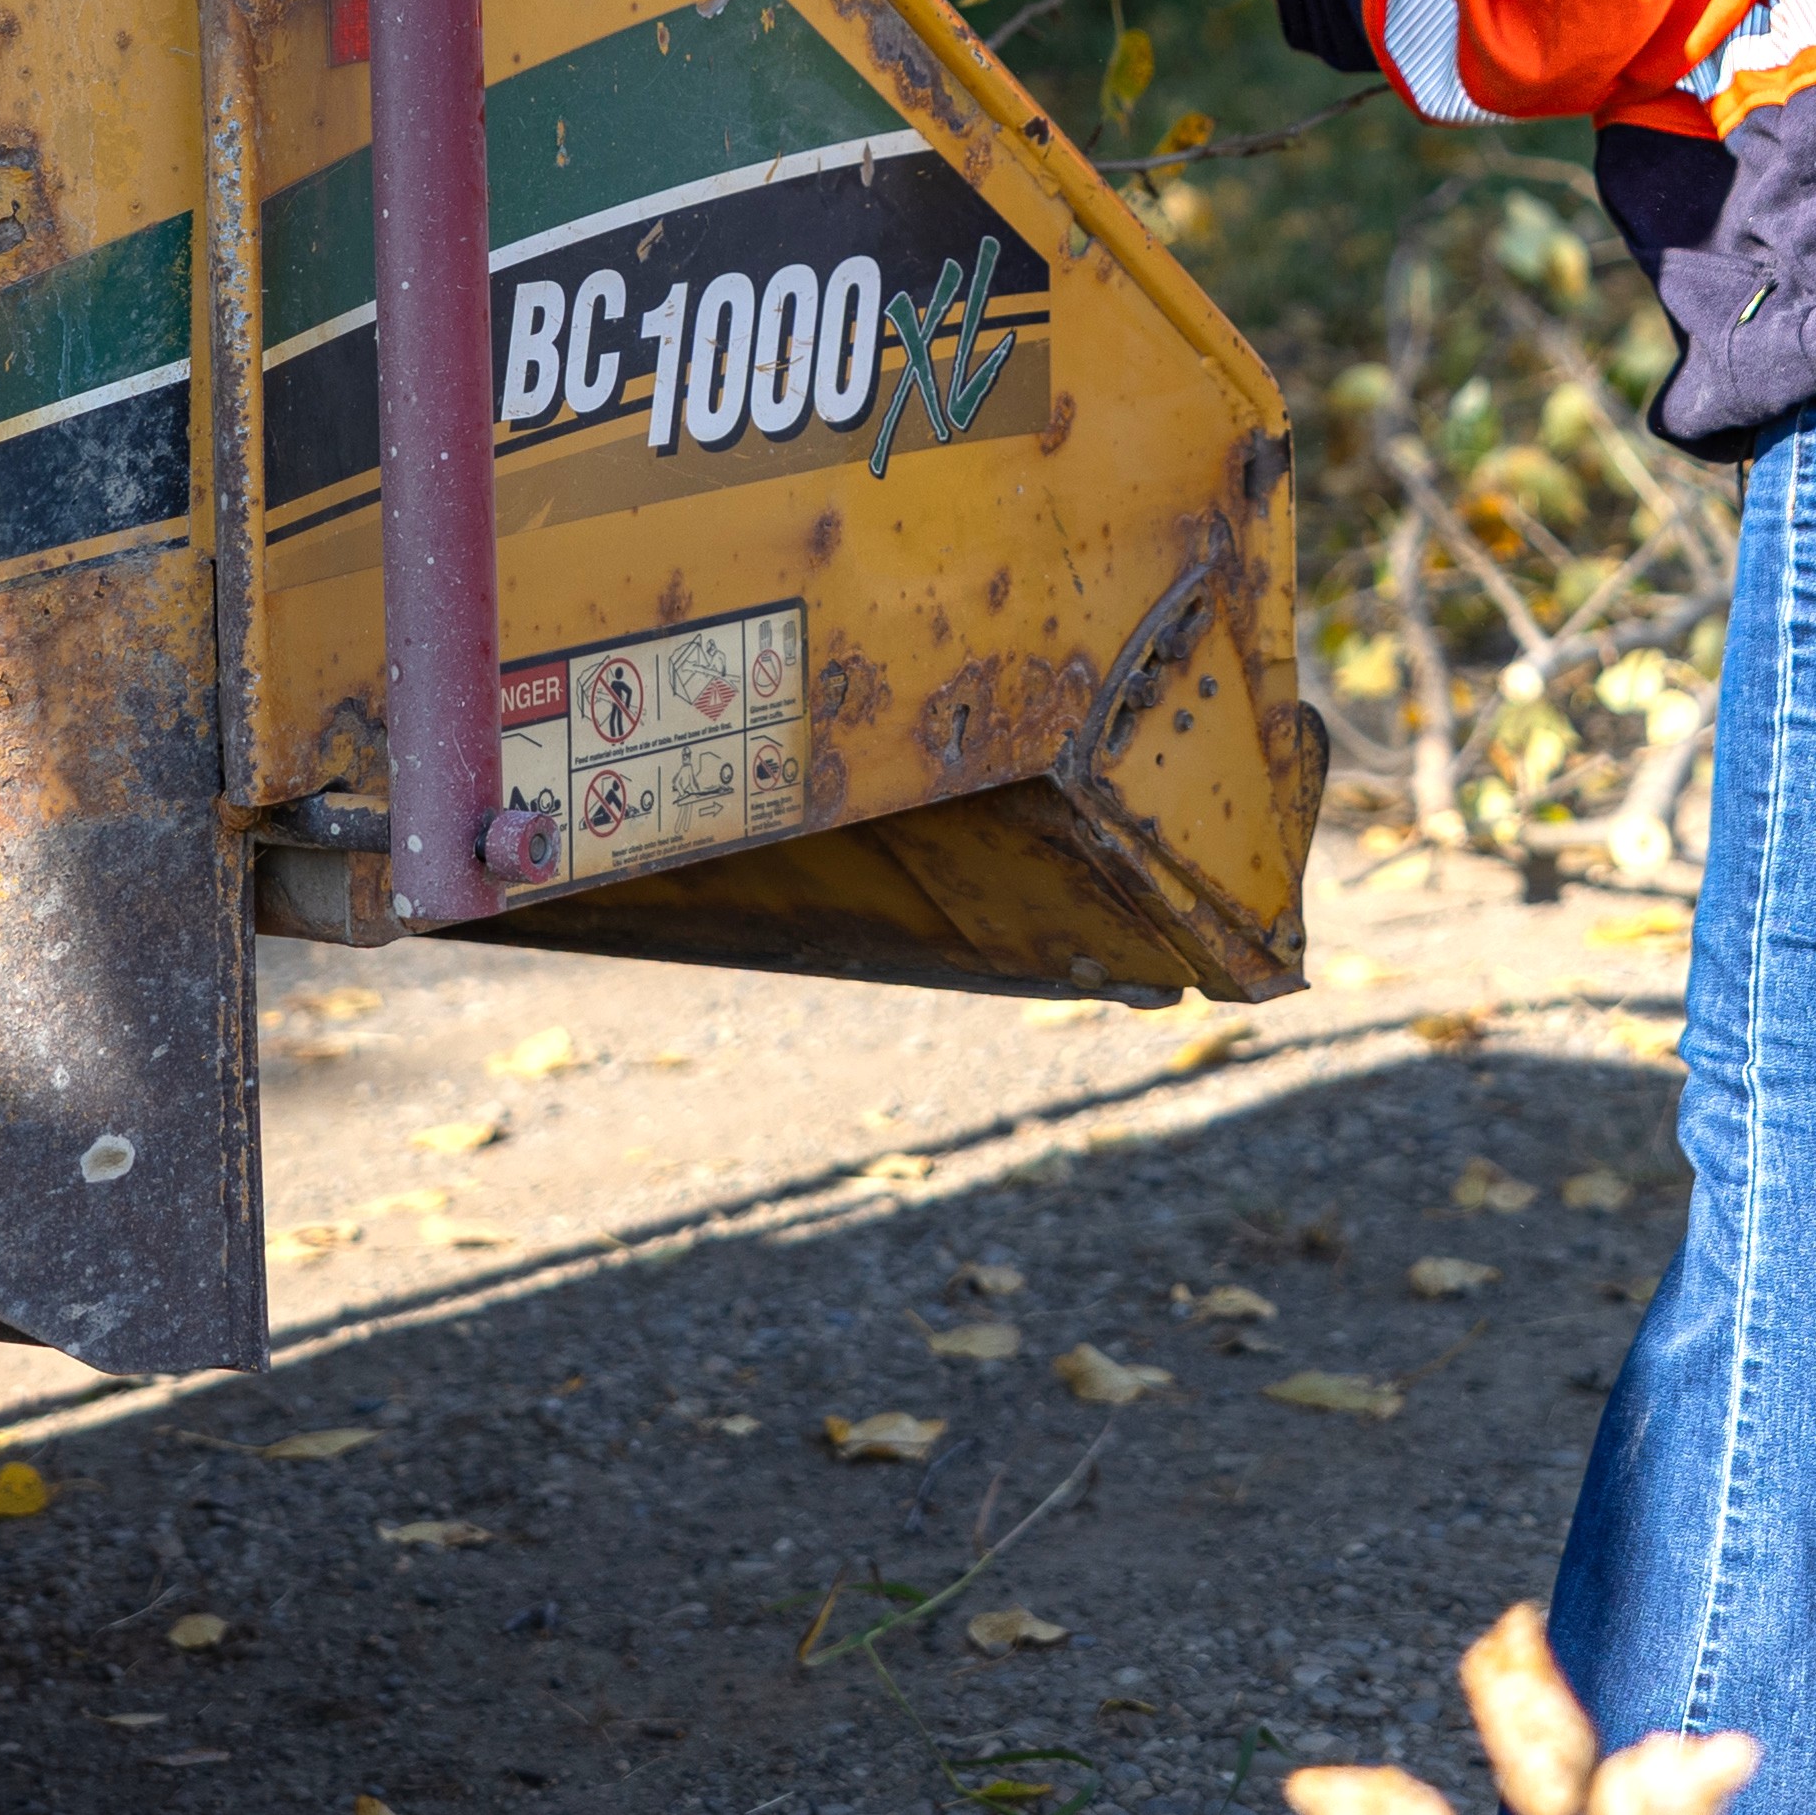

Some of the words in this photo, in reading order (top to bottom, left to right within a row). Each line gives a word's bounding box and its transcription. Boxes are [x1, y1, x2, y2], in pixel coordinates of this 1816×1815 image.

[612, 746, 625, 758] only
[625, 743, 638, 754] from
[674, 731, 687, 742] Feed
